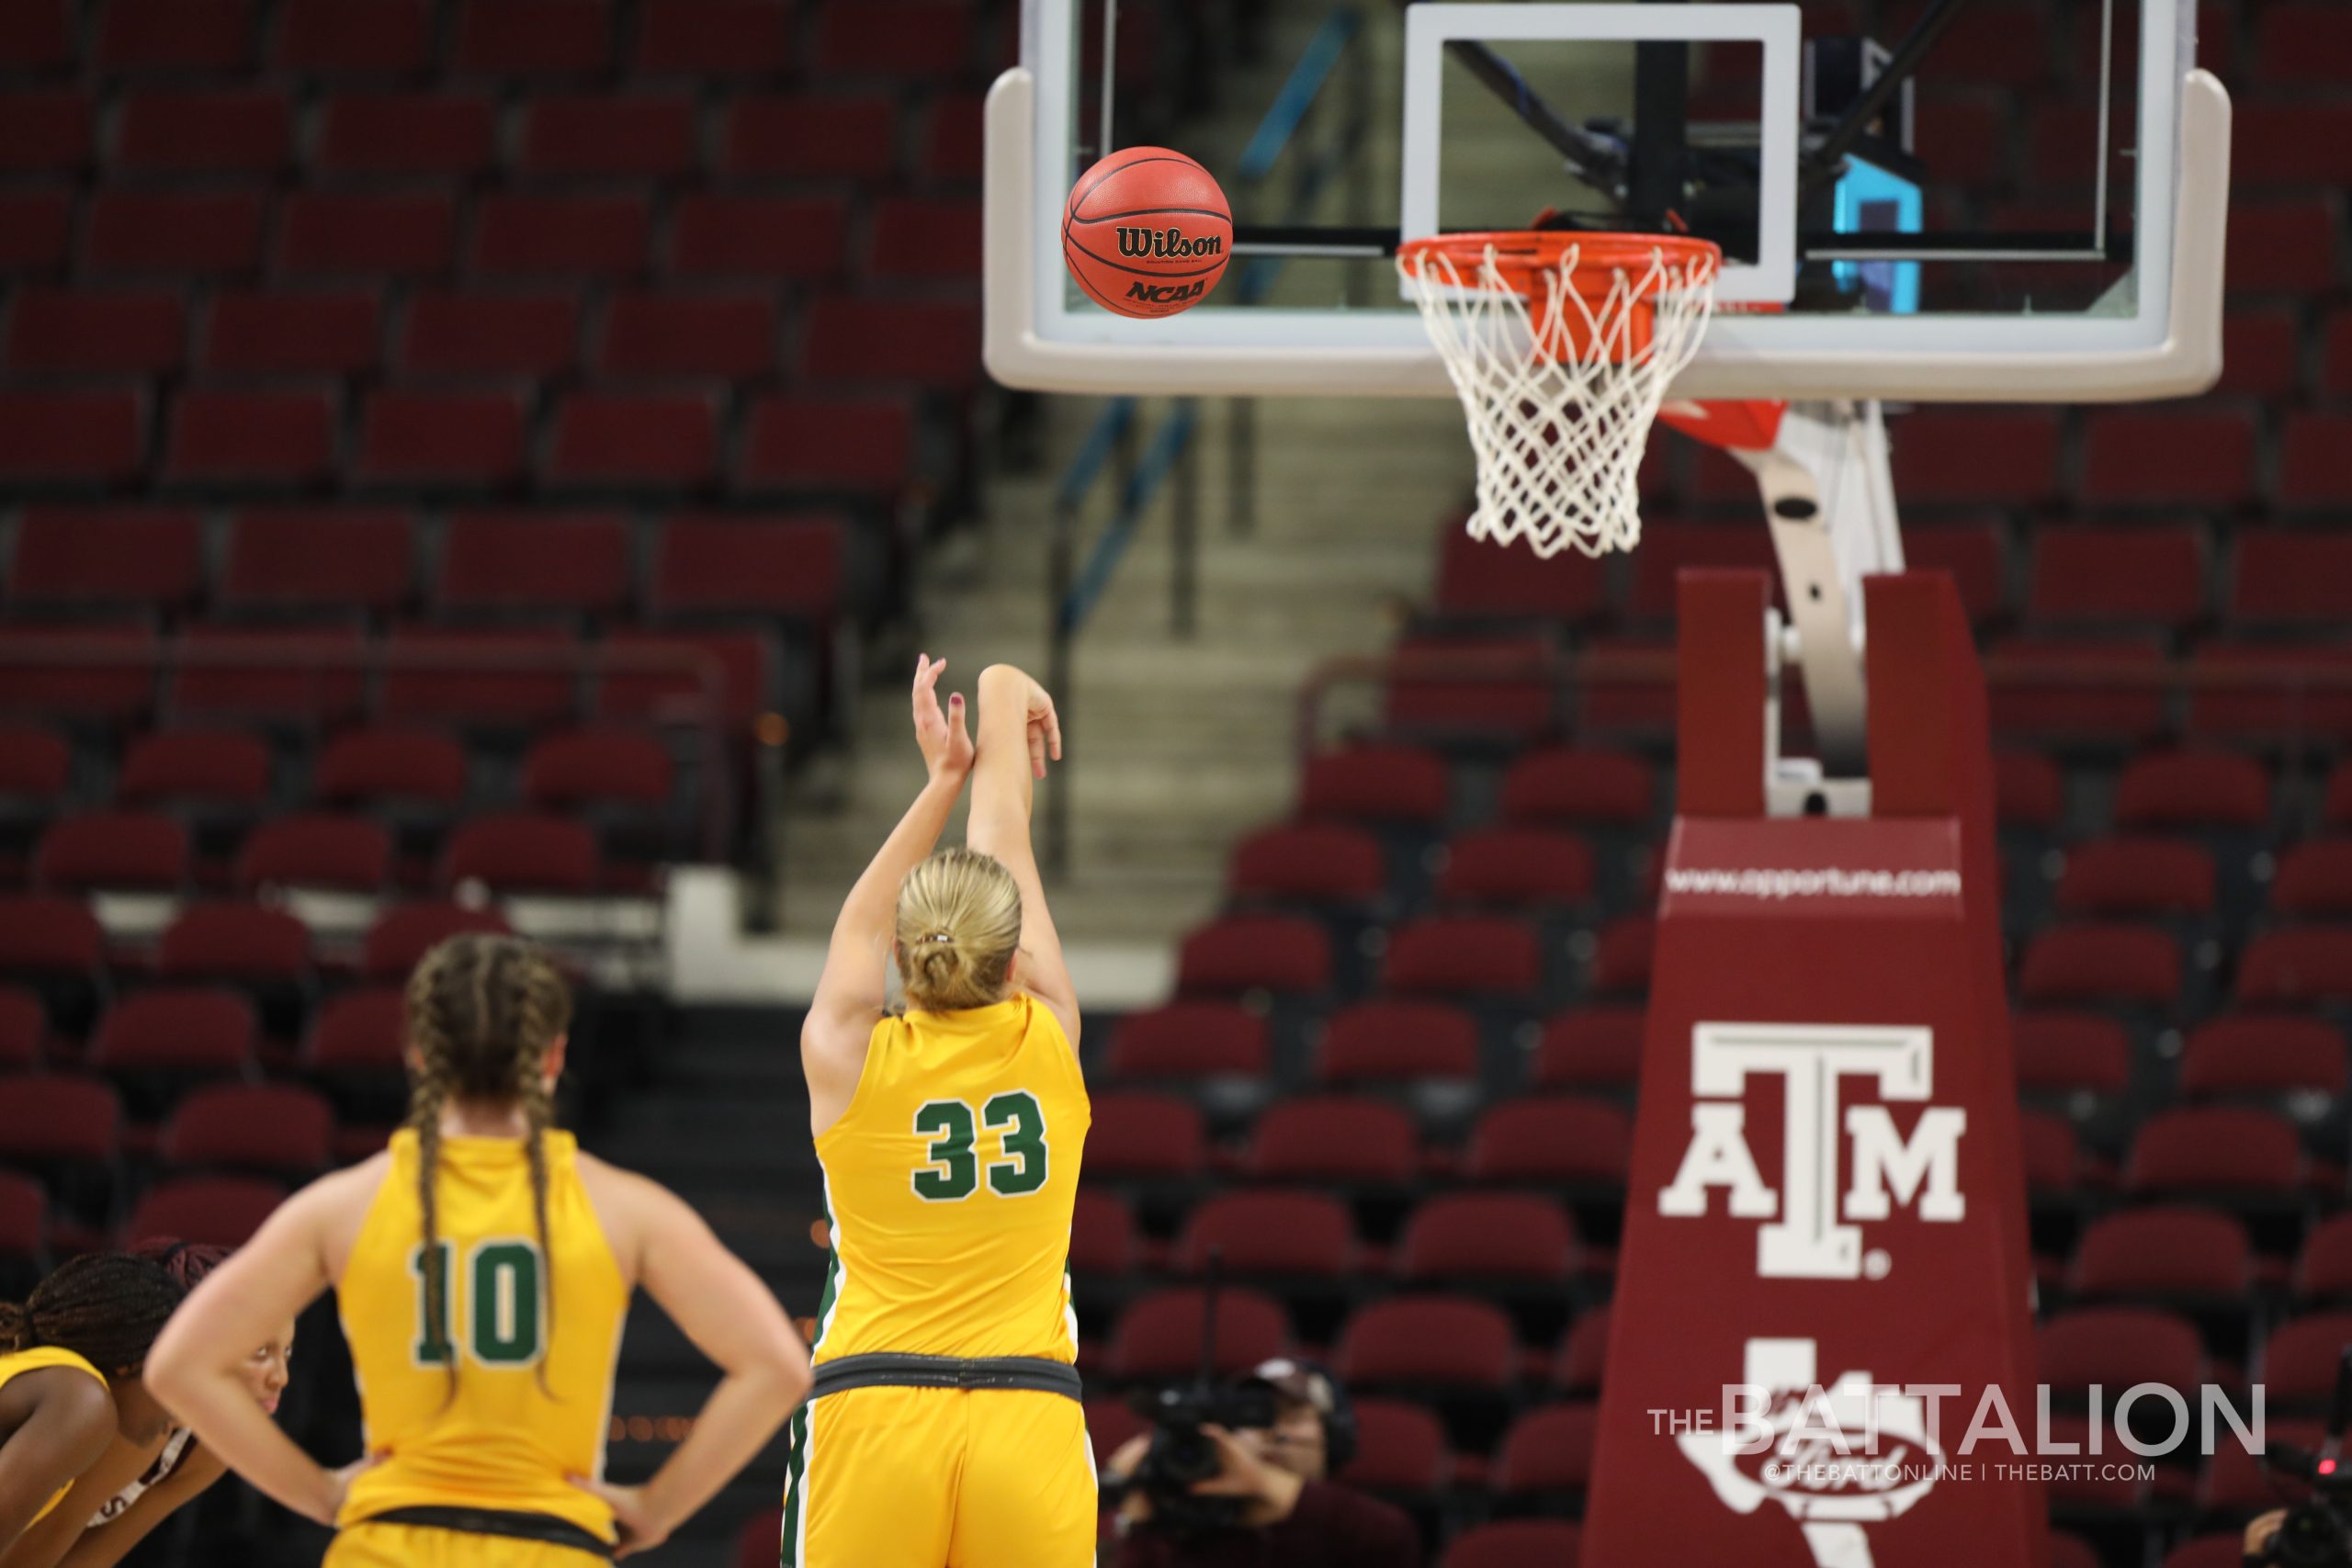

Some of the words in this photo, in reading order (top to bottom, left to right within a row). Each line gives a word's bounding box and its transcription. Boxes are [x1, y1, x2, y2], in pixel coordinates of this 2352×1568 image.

[1116, 227, 1221, 259] Wilson
[1125, 278, 1205, 303] NCAA
[910, 1089, 1049, 1202] 33
[407, 1235, 548, 1370] 10
